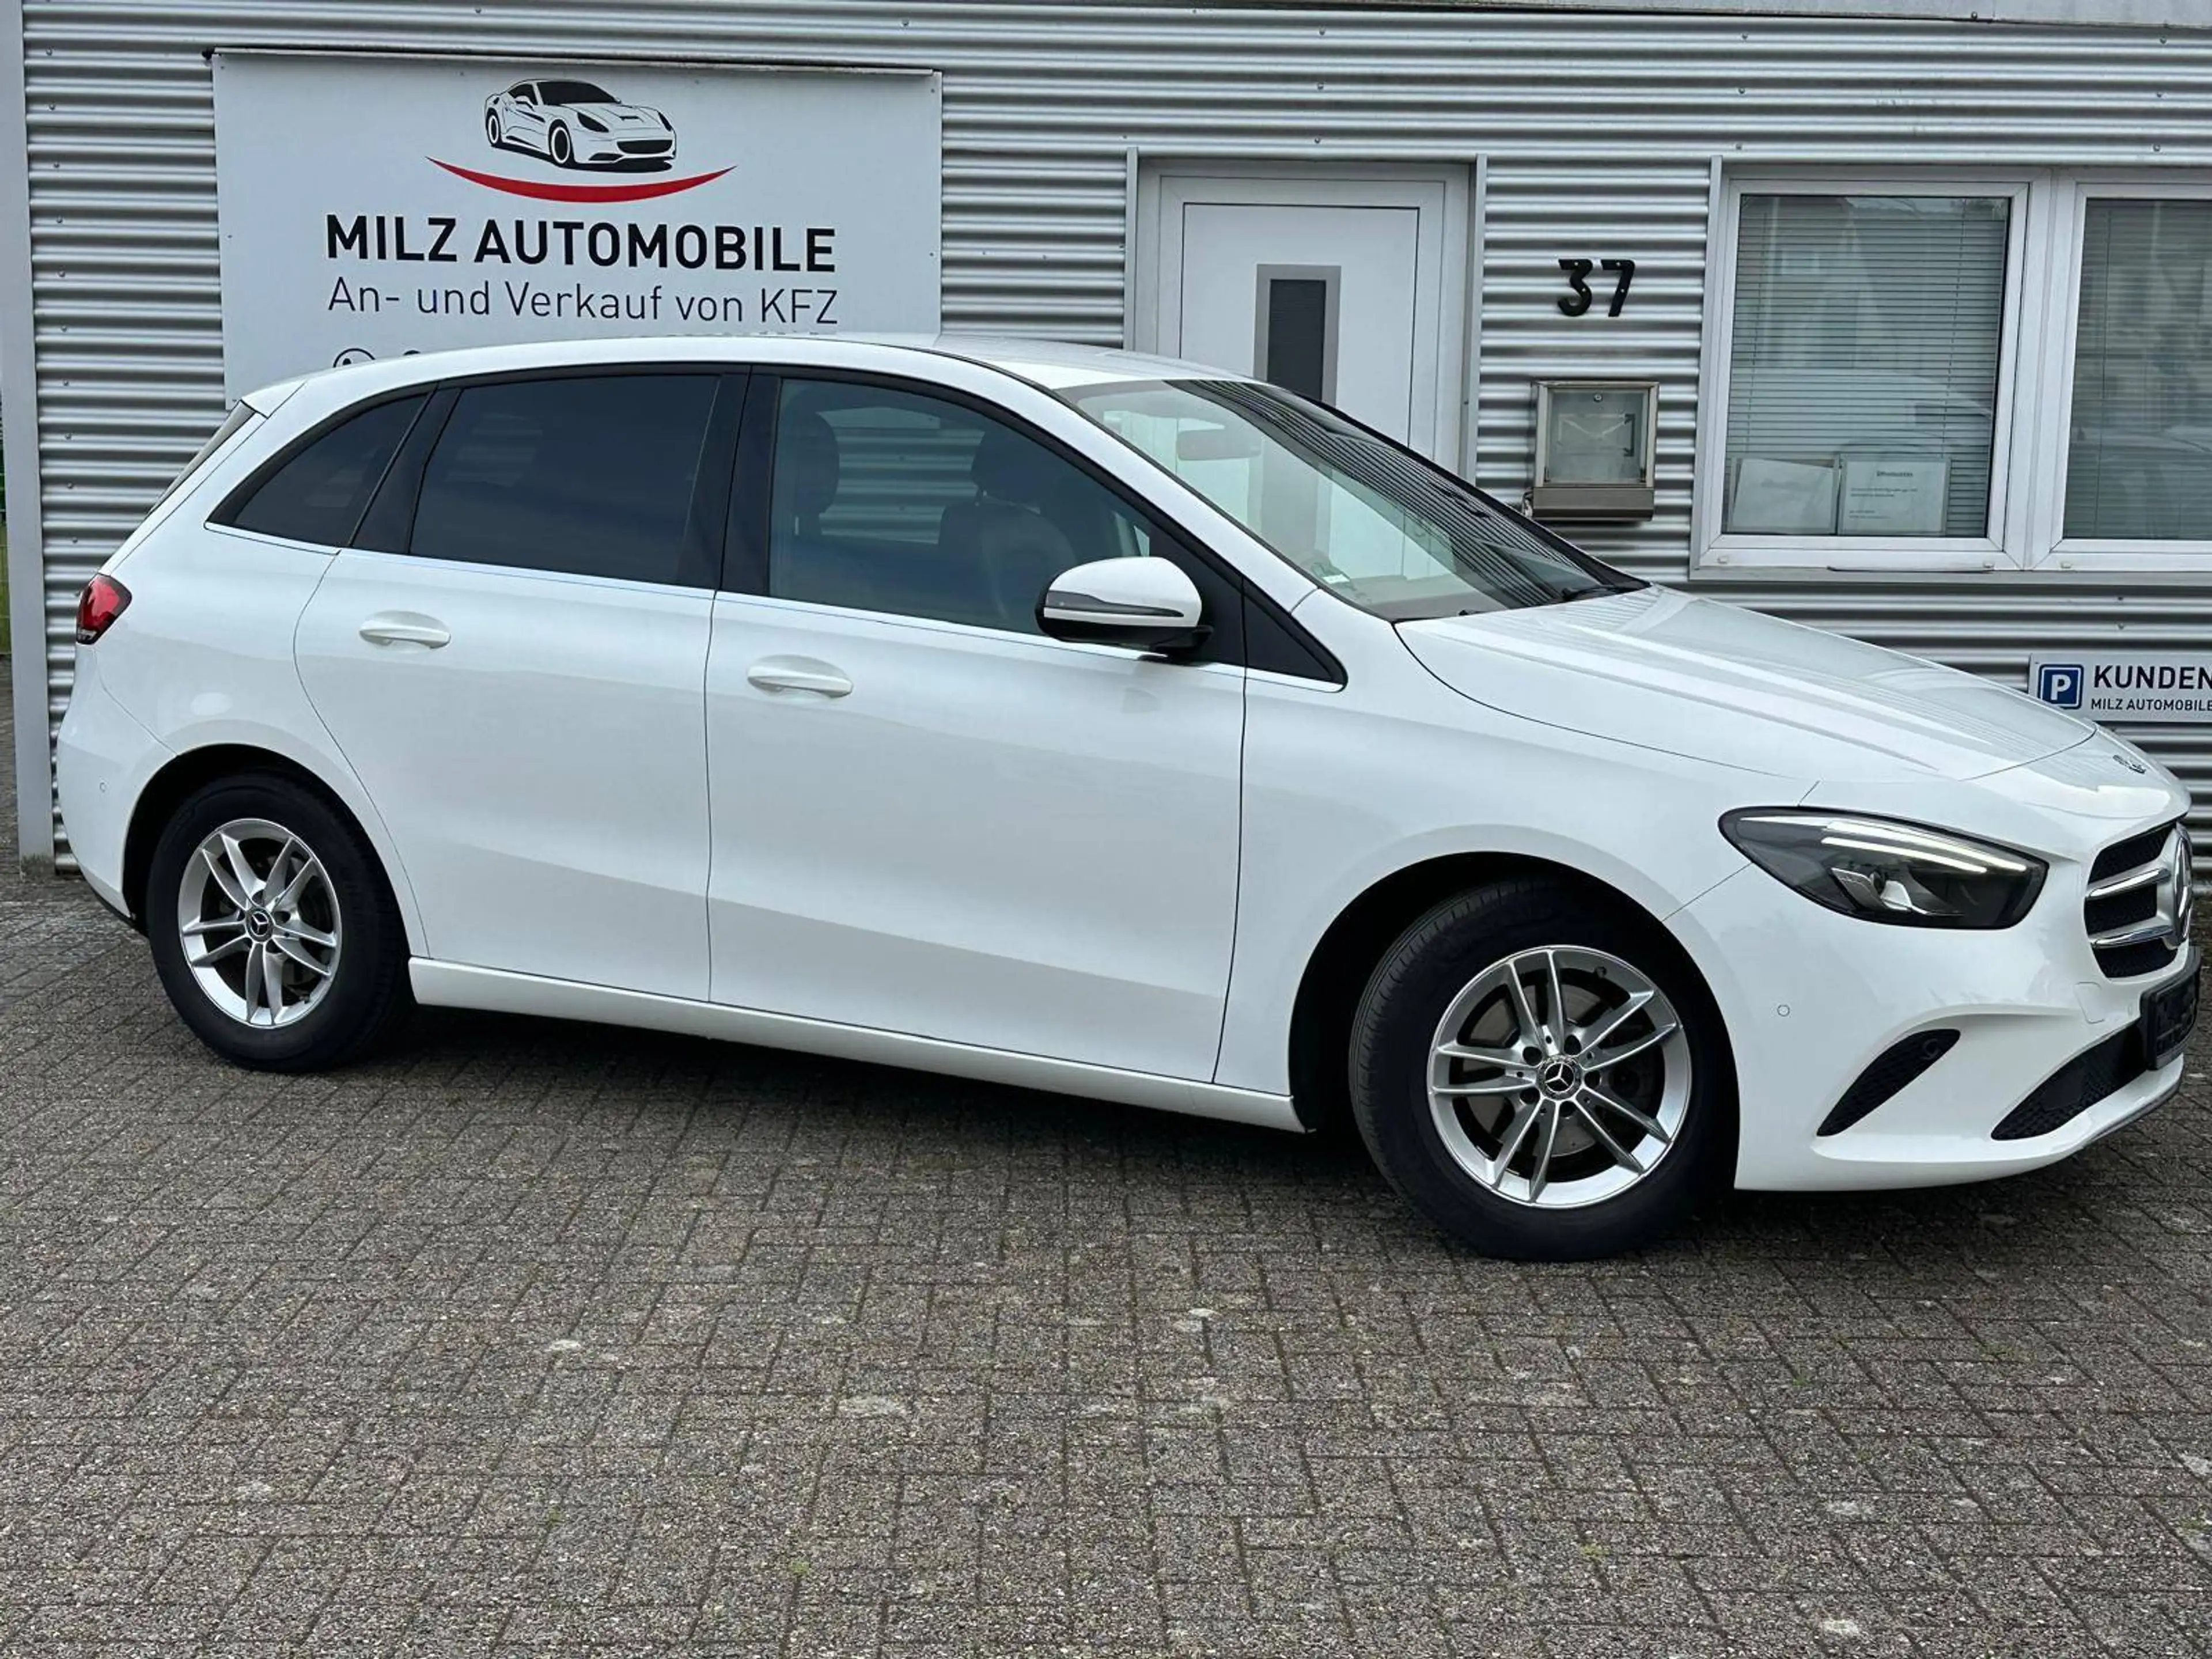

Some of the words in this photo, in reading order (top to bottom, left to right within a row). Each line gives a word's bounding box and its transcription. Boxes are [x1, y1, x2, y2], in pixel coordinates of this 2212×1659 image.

[326, 214, 457, 263] MILZ
[474, 218, 836, 272] AUTOMOBILE
[328, 276, 400, 312] An-
[417, 280, 489, 315] und
[505, 281, 662, 320] Verkauf
[675, 294, 743, 322] von
[761, 288, 838, 324] KFZ
[1557, 258, 1636, 317] 37
[2050, 674, 2072, 701] P
[2093, 665, 2212, 690] KUNDEN
[2091, 698, 2123, 710] MILZ
[2126, 699, 2212, 711] AUTOMOBILE
